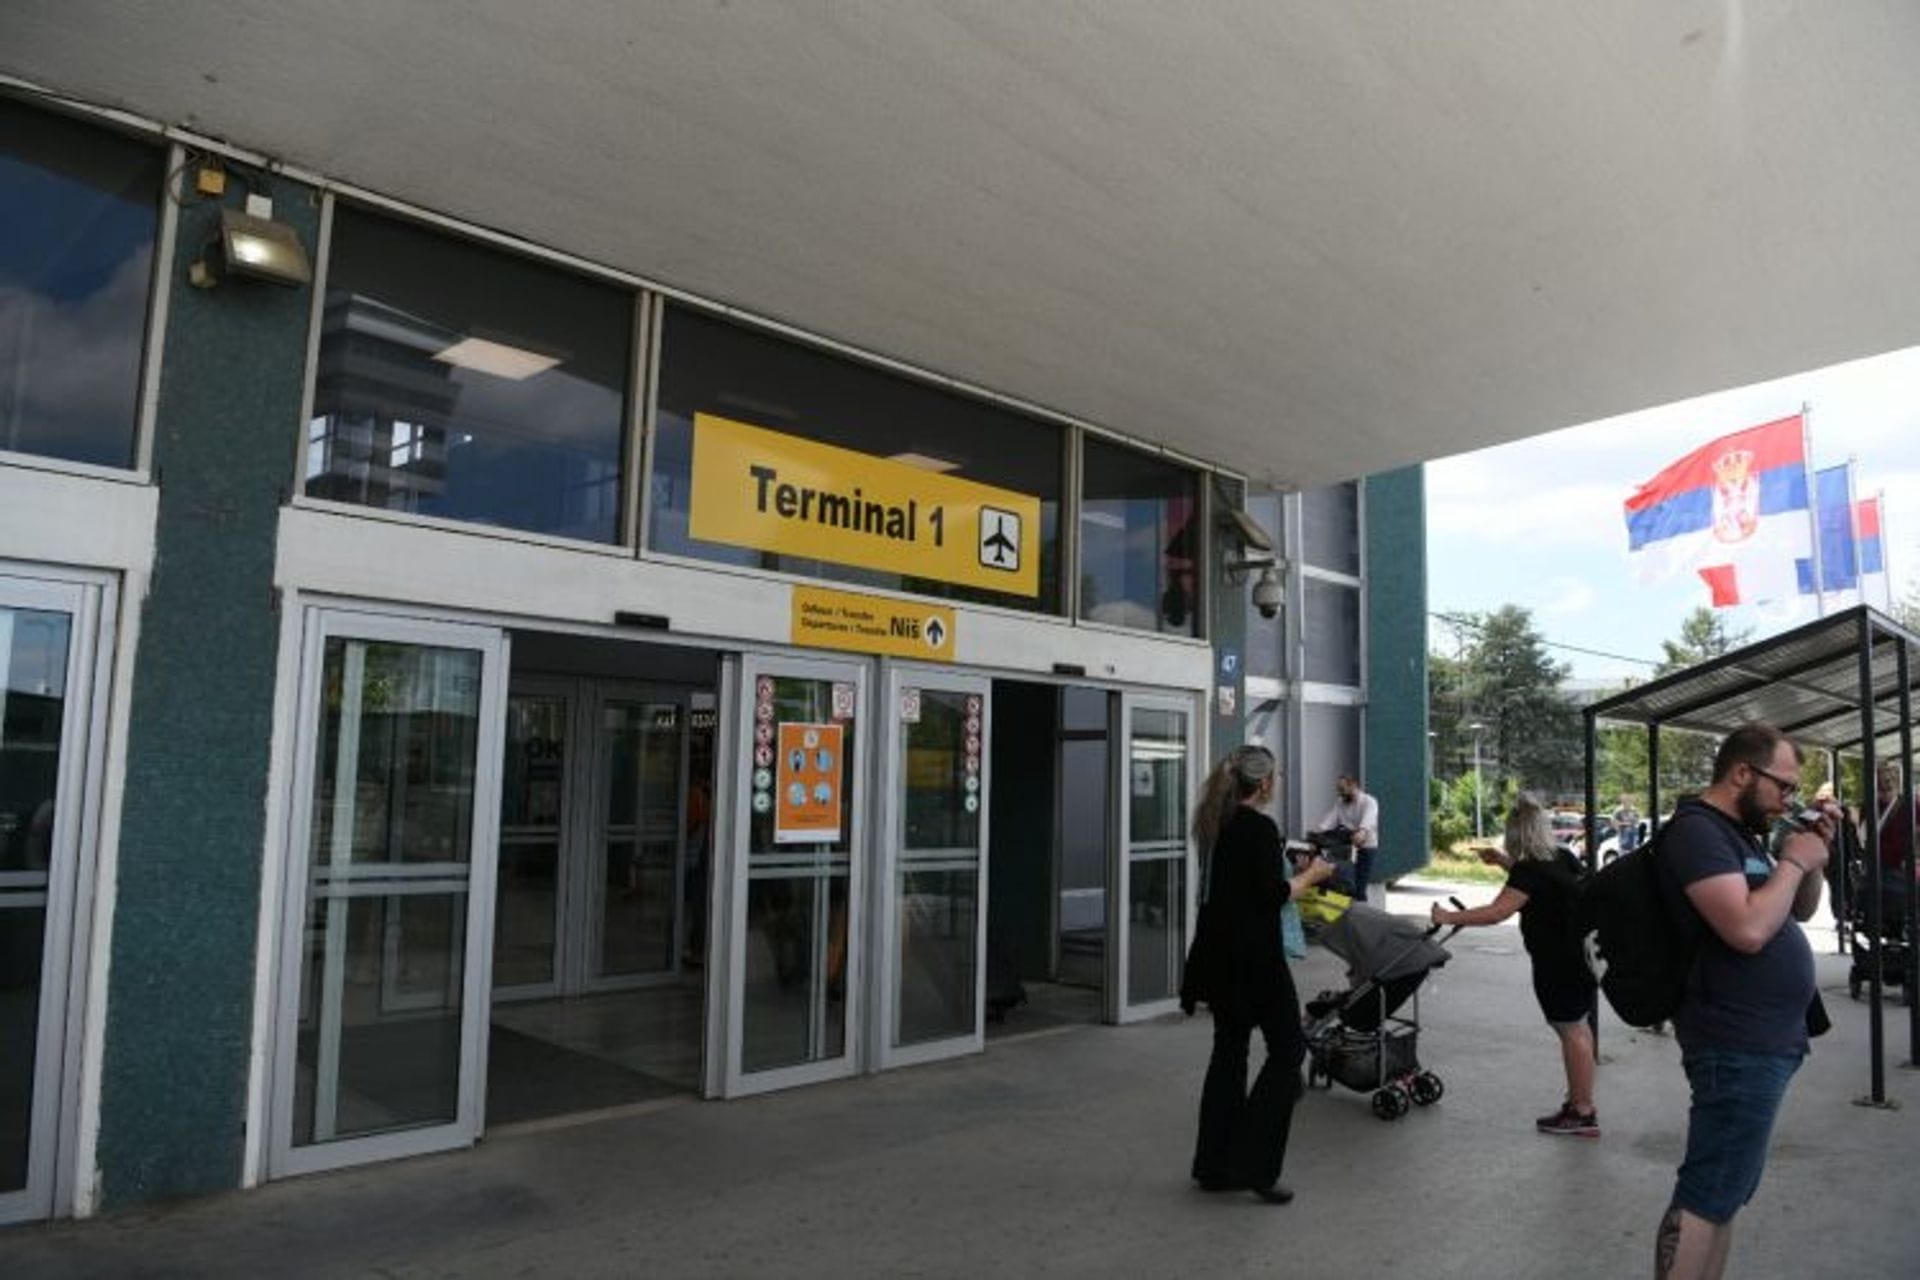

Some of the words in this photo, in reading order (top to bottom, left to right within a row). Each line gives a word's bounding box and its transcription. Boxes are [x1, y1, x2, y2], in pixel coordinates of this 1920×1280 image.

[750, 464, 916, 542] Terminal
[929, 506, 944, 547] 1
[890, 615, 921, 640] Niš
